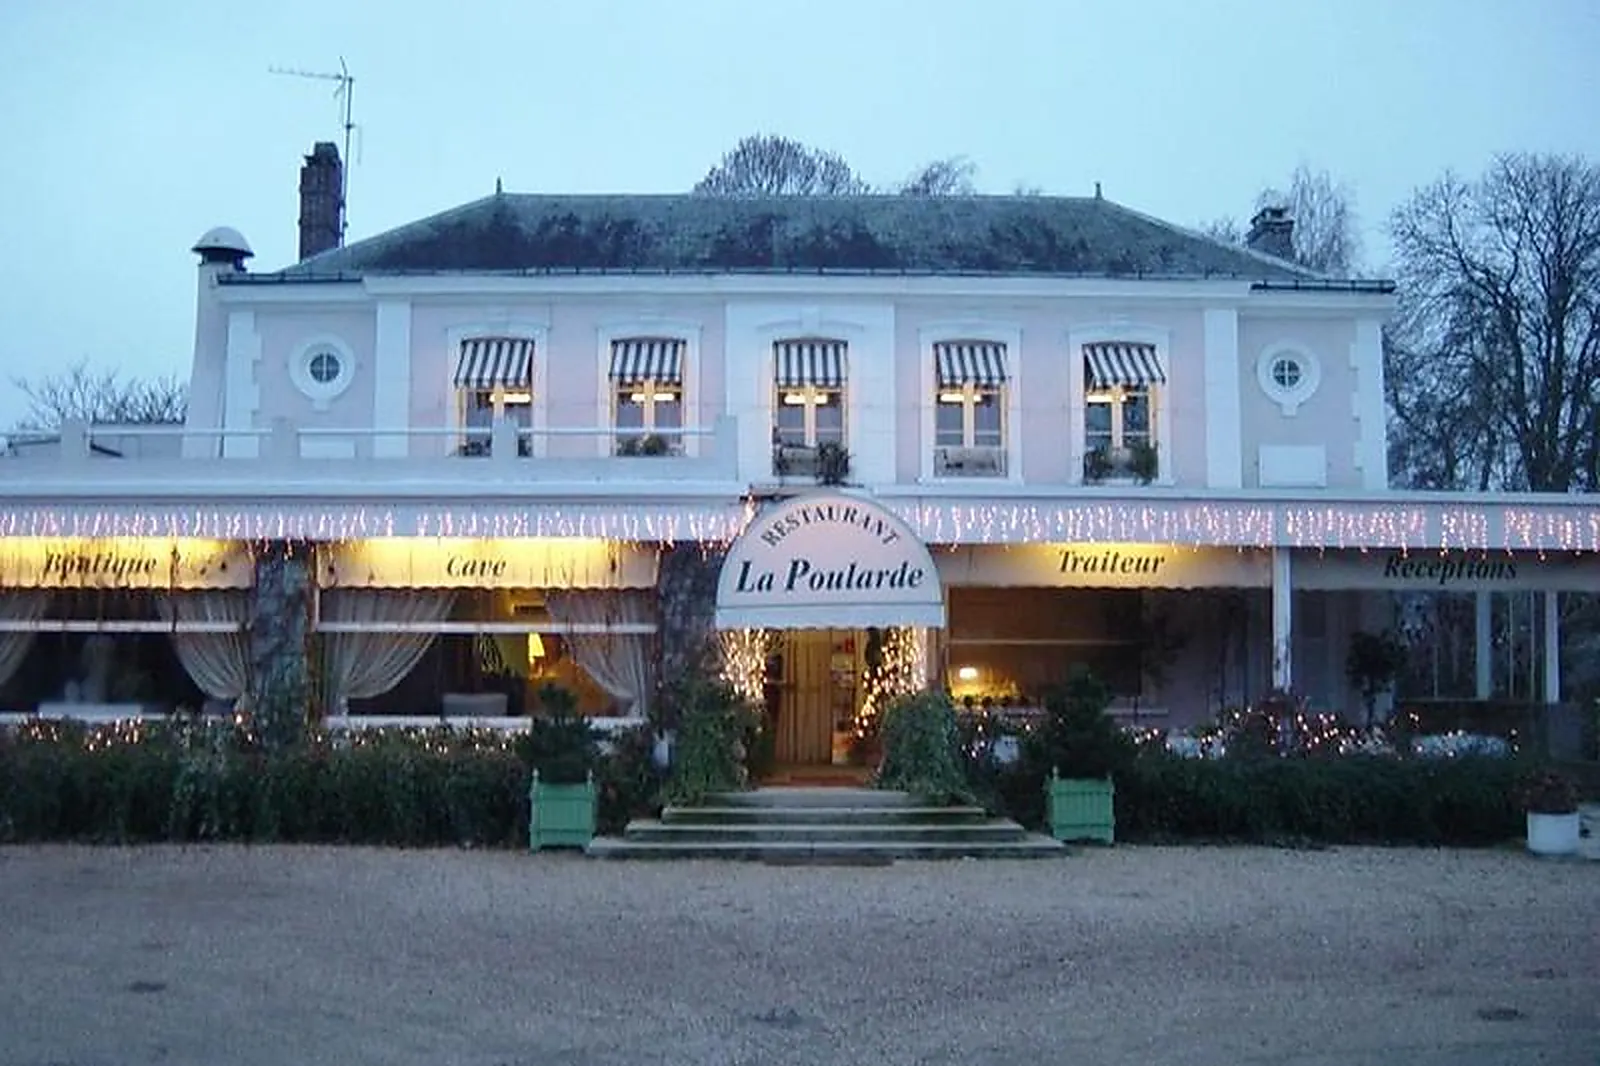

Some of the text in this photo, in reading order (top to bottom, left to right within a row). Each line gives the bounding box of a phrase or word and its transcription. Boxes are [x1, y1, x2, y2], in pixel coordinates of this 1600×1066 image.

[761, 503, 900, 547] RESTAURANT
[42, 551, 158, 580] Boutique
[446, 554, 507, 578] Cave
[736, 557, 924, 593] La Poularde
[1058, 549, 1165, 573] Traiteur
